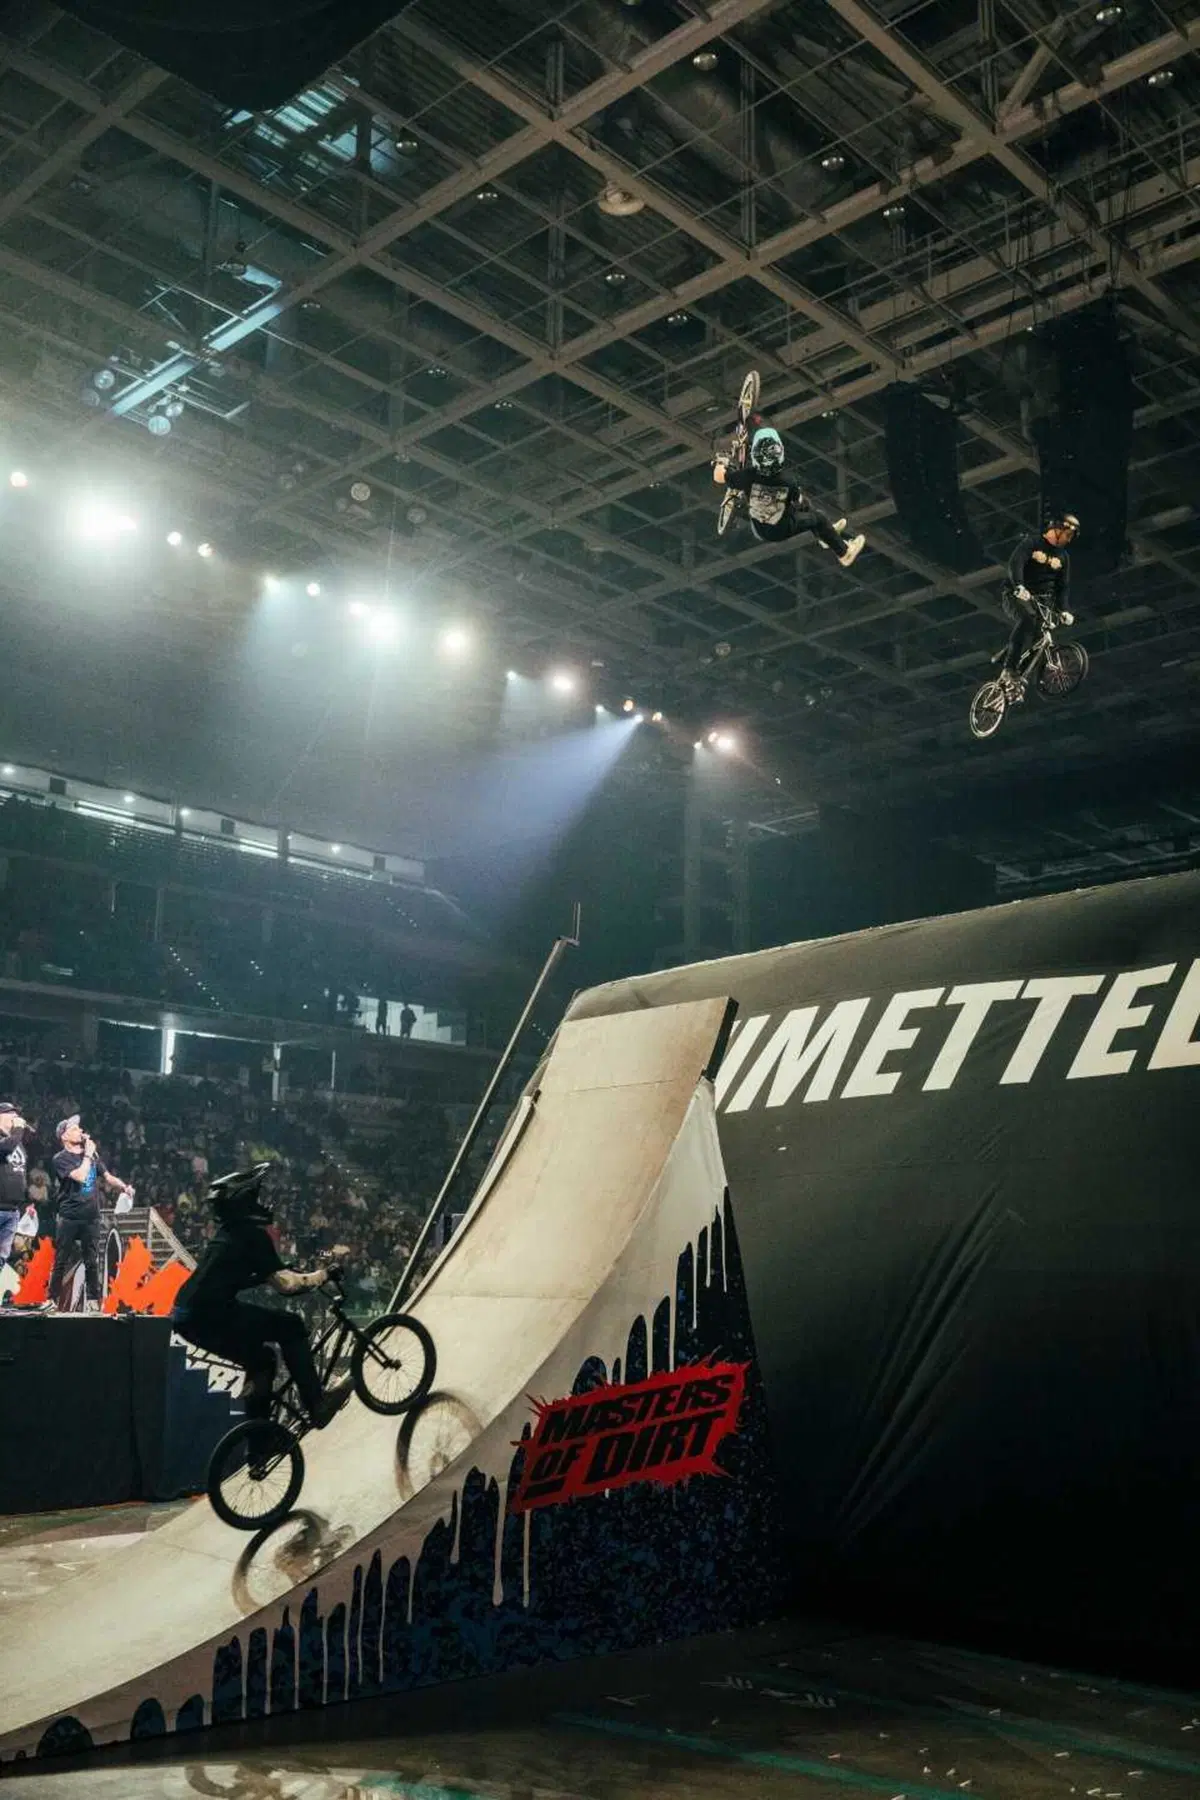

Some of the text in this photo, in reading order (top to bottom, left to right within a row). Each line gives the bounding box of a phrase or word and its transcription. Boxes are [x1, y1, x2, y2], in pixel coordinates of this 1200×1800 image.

[538, 1374, 736, 1446] MASTERS
[530, 1410, 725, 1485] OF DIRT
